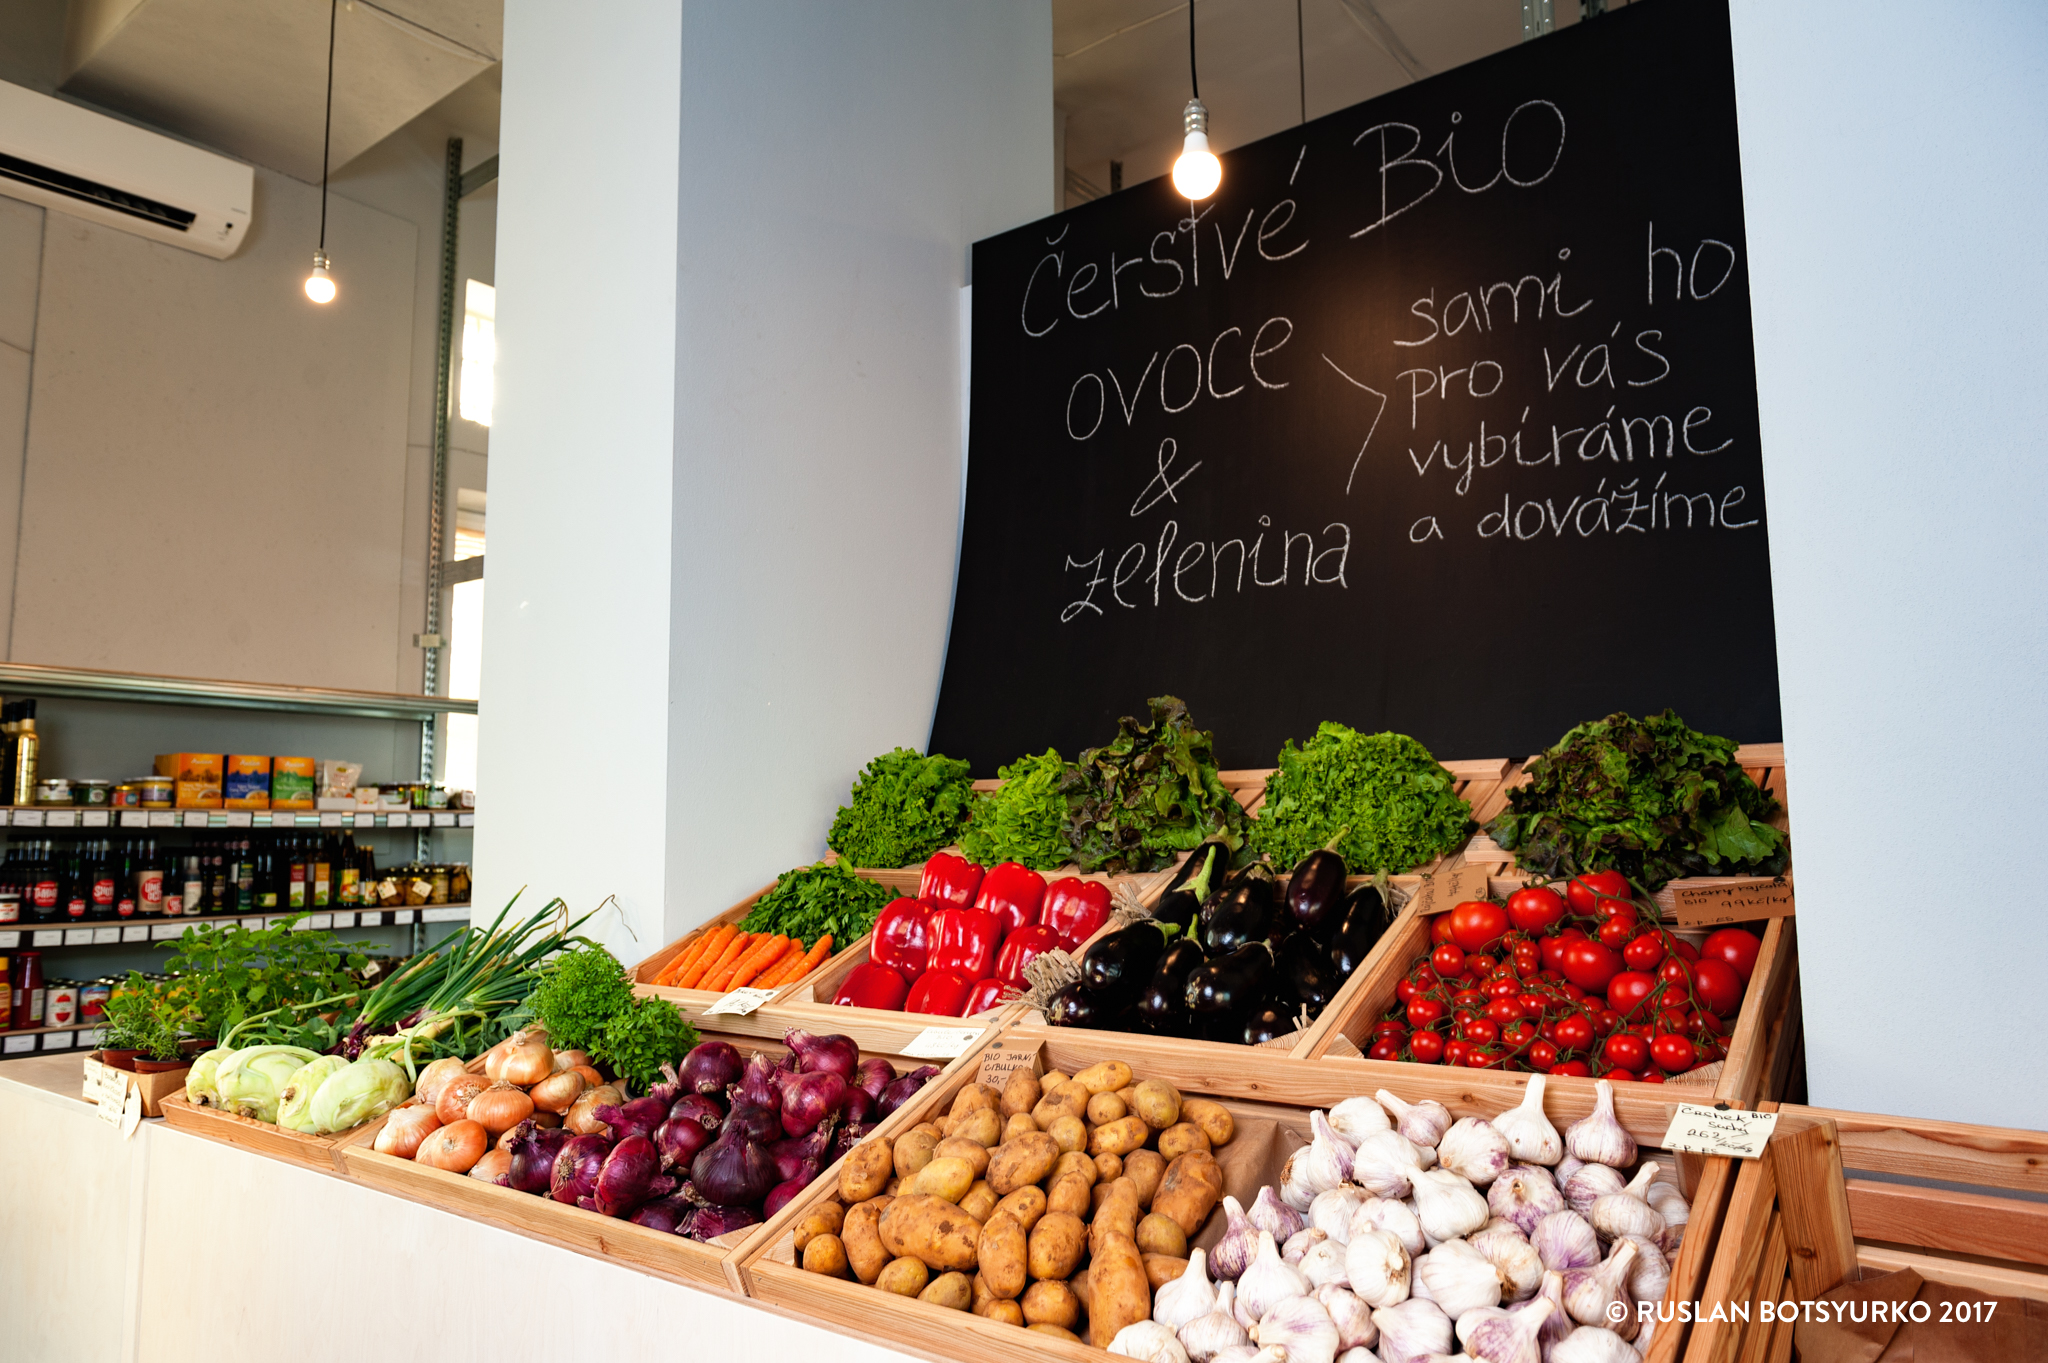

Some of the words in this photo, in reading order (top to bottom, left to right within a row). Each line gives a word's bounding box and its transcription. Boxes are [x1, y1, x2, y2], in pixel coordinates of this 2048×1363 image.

[1022, 144, 1310, 338] Čerstvé
[1393, 247, 1593, 346] sami
[1647, 220, 1735, 305] ho
[1066, 316, 1293, 440] ovoce
[1396, 360, 1503, 430] pro
[1543, 320, 1670, 392] vás
[1130, 437, 1203, 518] &
[1408, 405, 1734, 496] vybíráme
[1408, 515, 1444, 543] a
[1476, 470, 1759, 542] dovážíme
[1060, 514, 1349, 623] zelenina
[984, 1052, 1001, 1063] BIO
[1751, 1112, 1773, 1120] BIO
